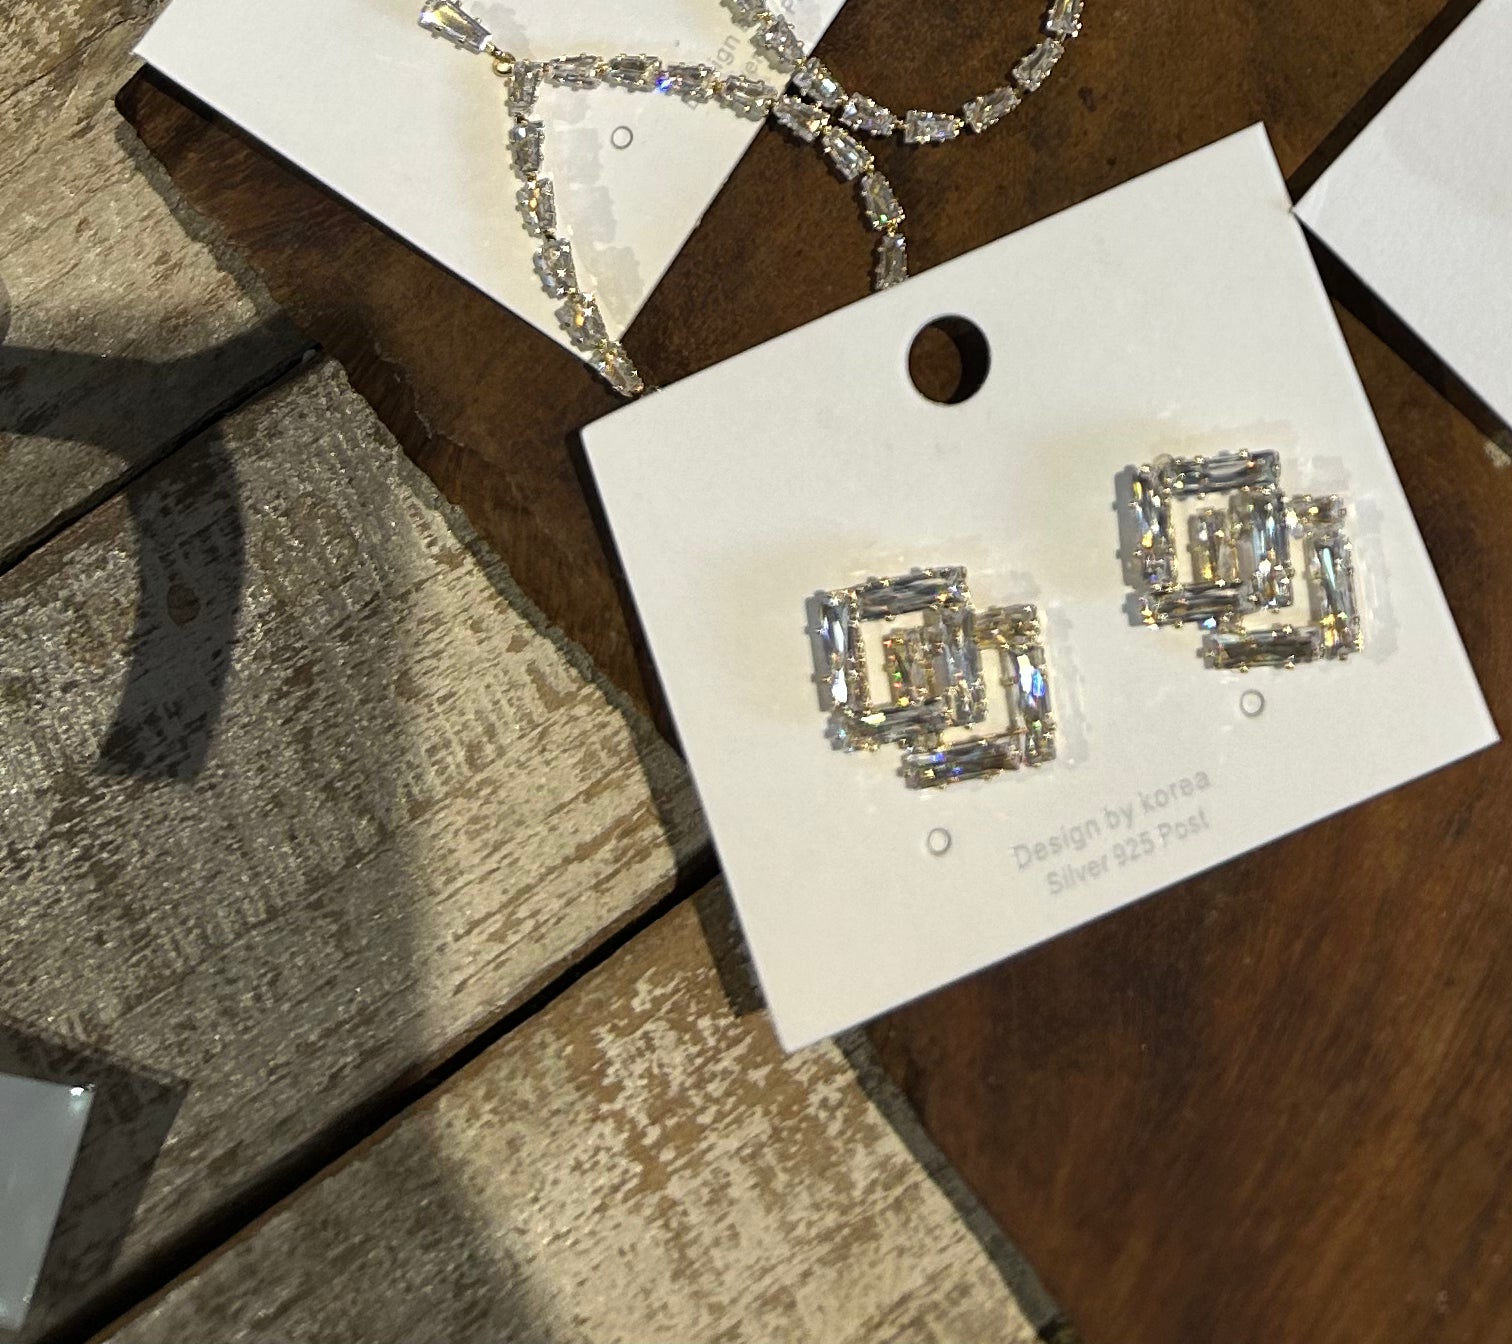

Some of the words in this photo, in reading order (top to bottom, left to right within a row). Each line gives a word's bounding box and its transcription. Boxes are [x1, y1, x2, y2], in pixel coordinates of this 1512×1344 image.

[1013, 819, 1100, 870] Design
[1103, 802, 1134, 830] by
[1137, 770, 1212, 814] korea
[1046, 853, 1110, 894] Silver
[1111, 831, 1155, 866] 925
[1157, 809, 1211, 847] Post
